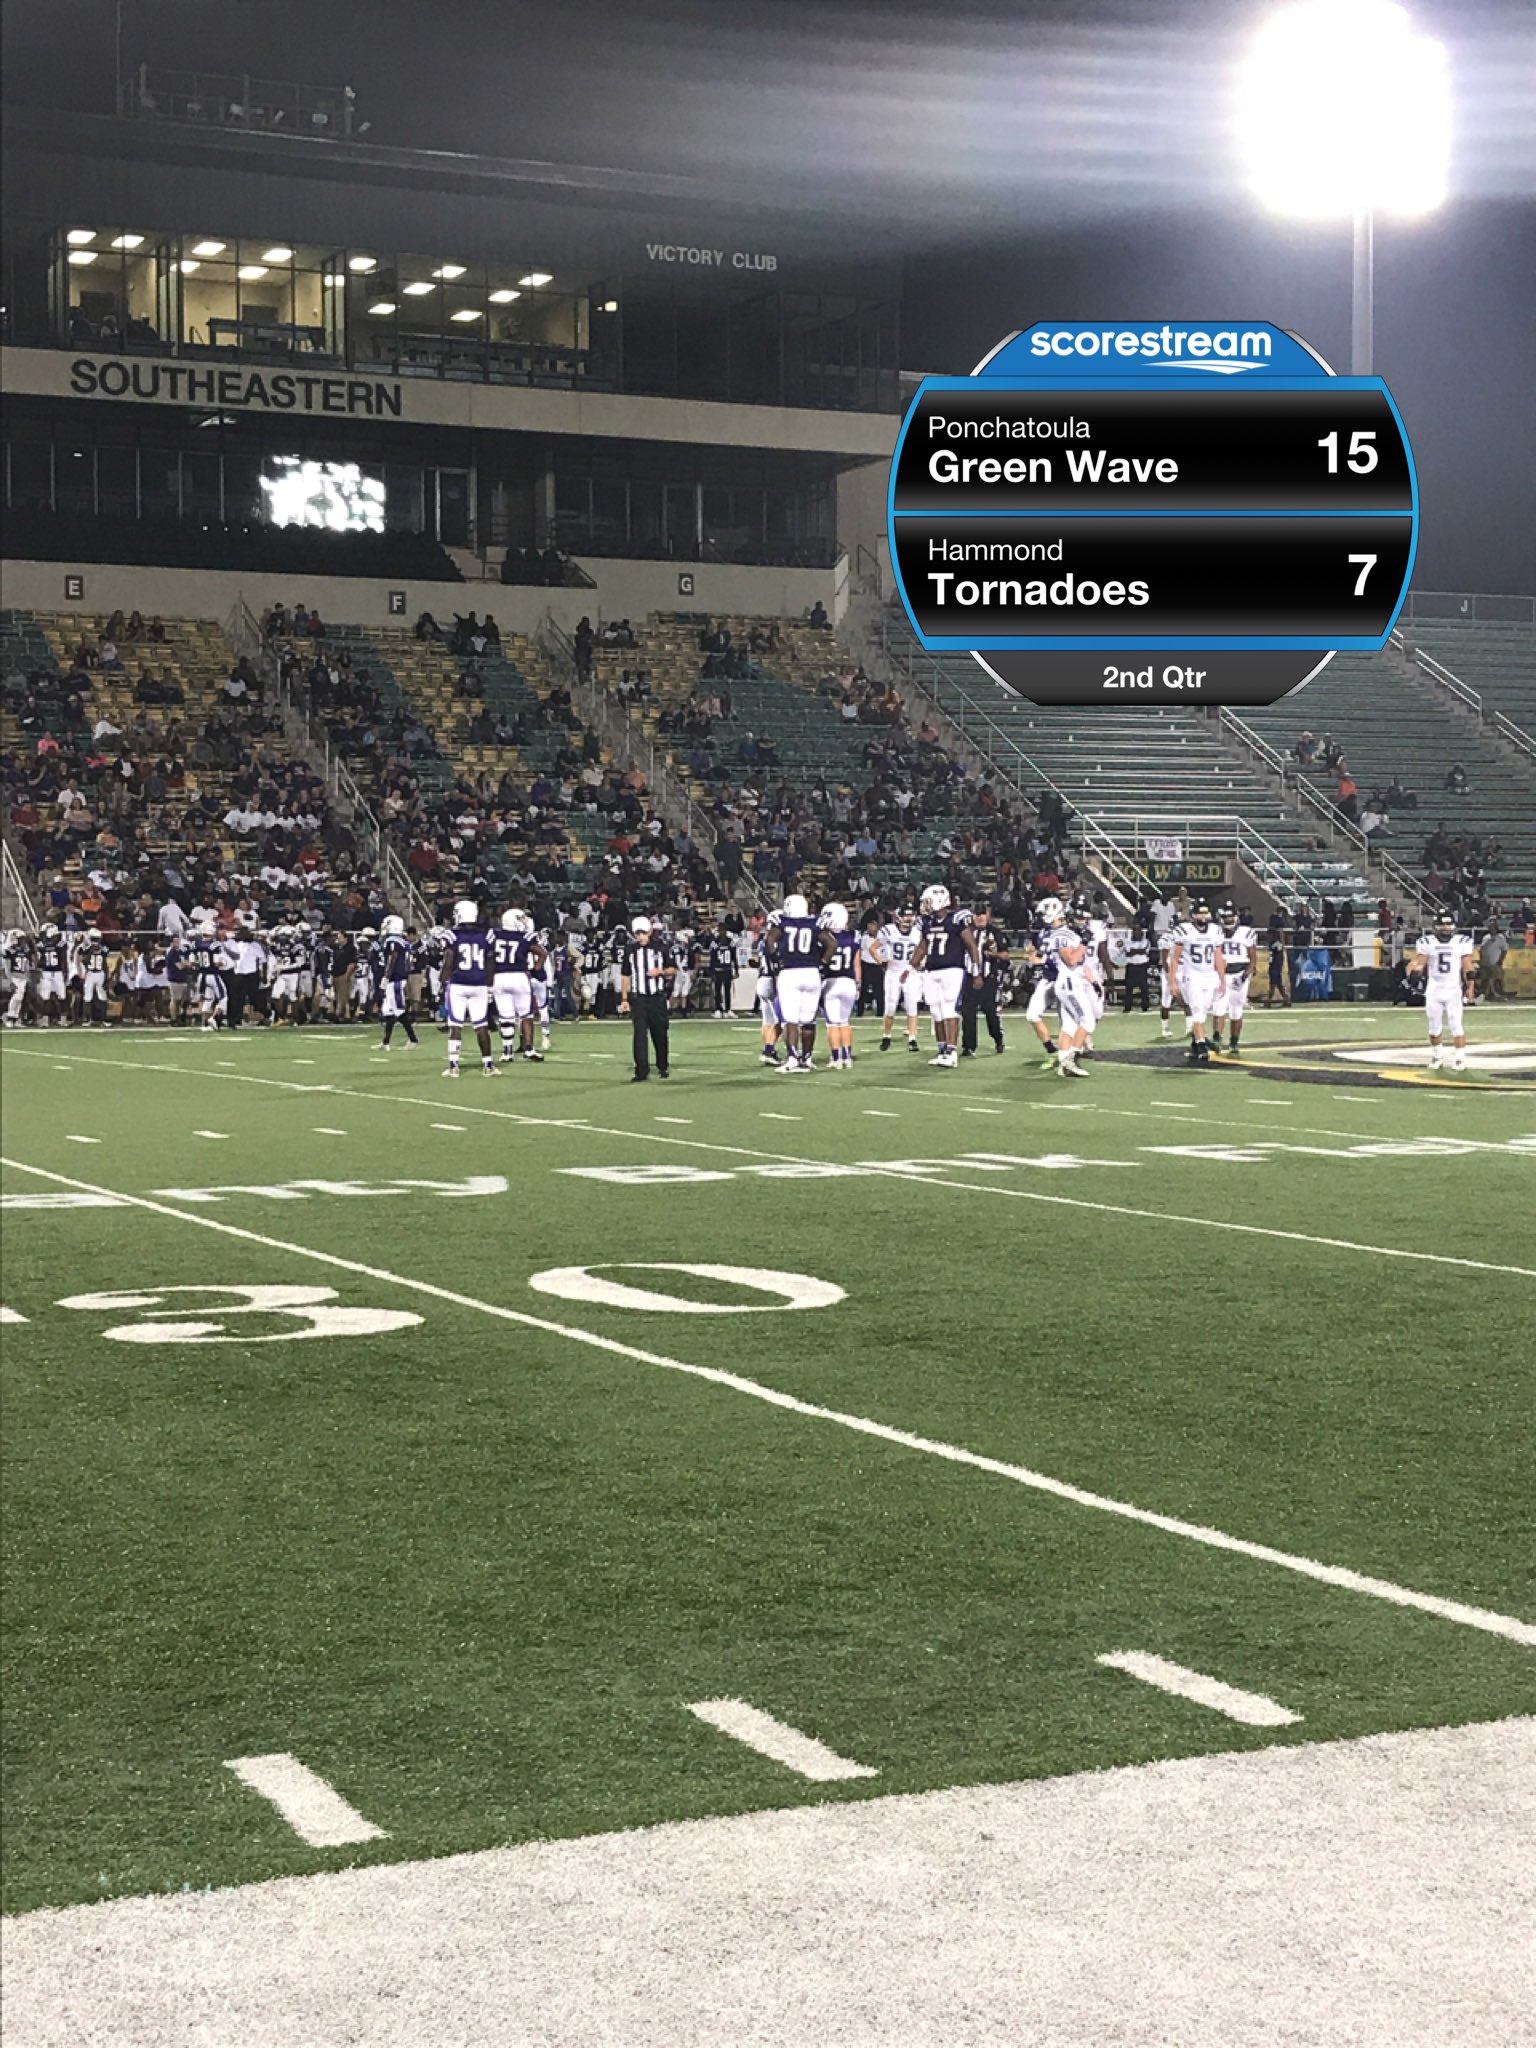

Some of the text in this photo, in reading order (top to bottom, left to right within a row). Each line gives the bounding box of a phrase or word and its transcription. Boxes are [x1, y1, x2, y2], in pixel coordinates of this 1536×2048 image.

[646, 243, 777, 271] VICTORY CLUB
[70, 359, 402, 416] SOUTHEASTERN
[68, 580, 81, 596] E
[681, 578, 692, 592] G
[392, 595, 403, 611] F
[495, 940, 519, 963] 57
[784, 926, 812, 954] 70
[926, 932, 949, 955] 77
[458, 943, 485, 970] 34
[829, 946, 852, 970] 51
[1190, 944, 1214, 964] 50
[1438, 952, 1450, 973] 5
